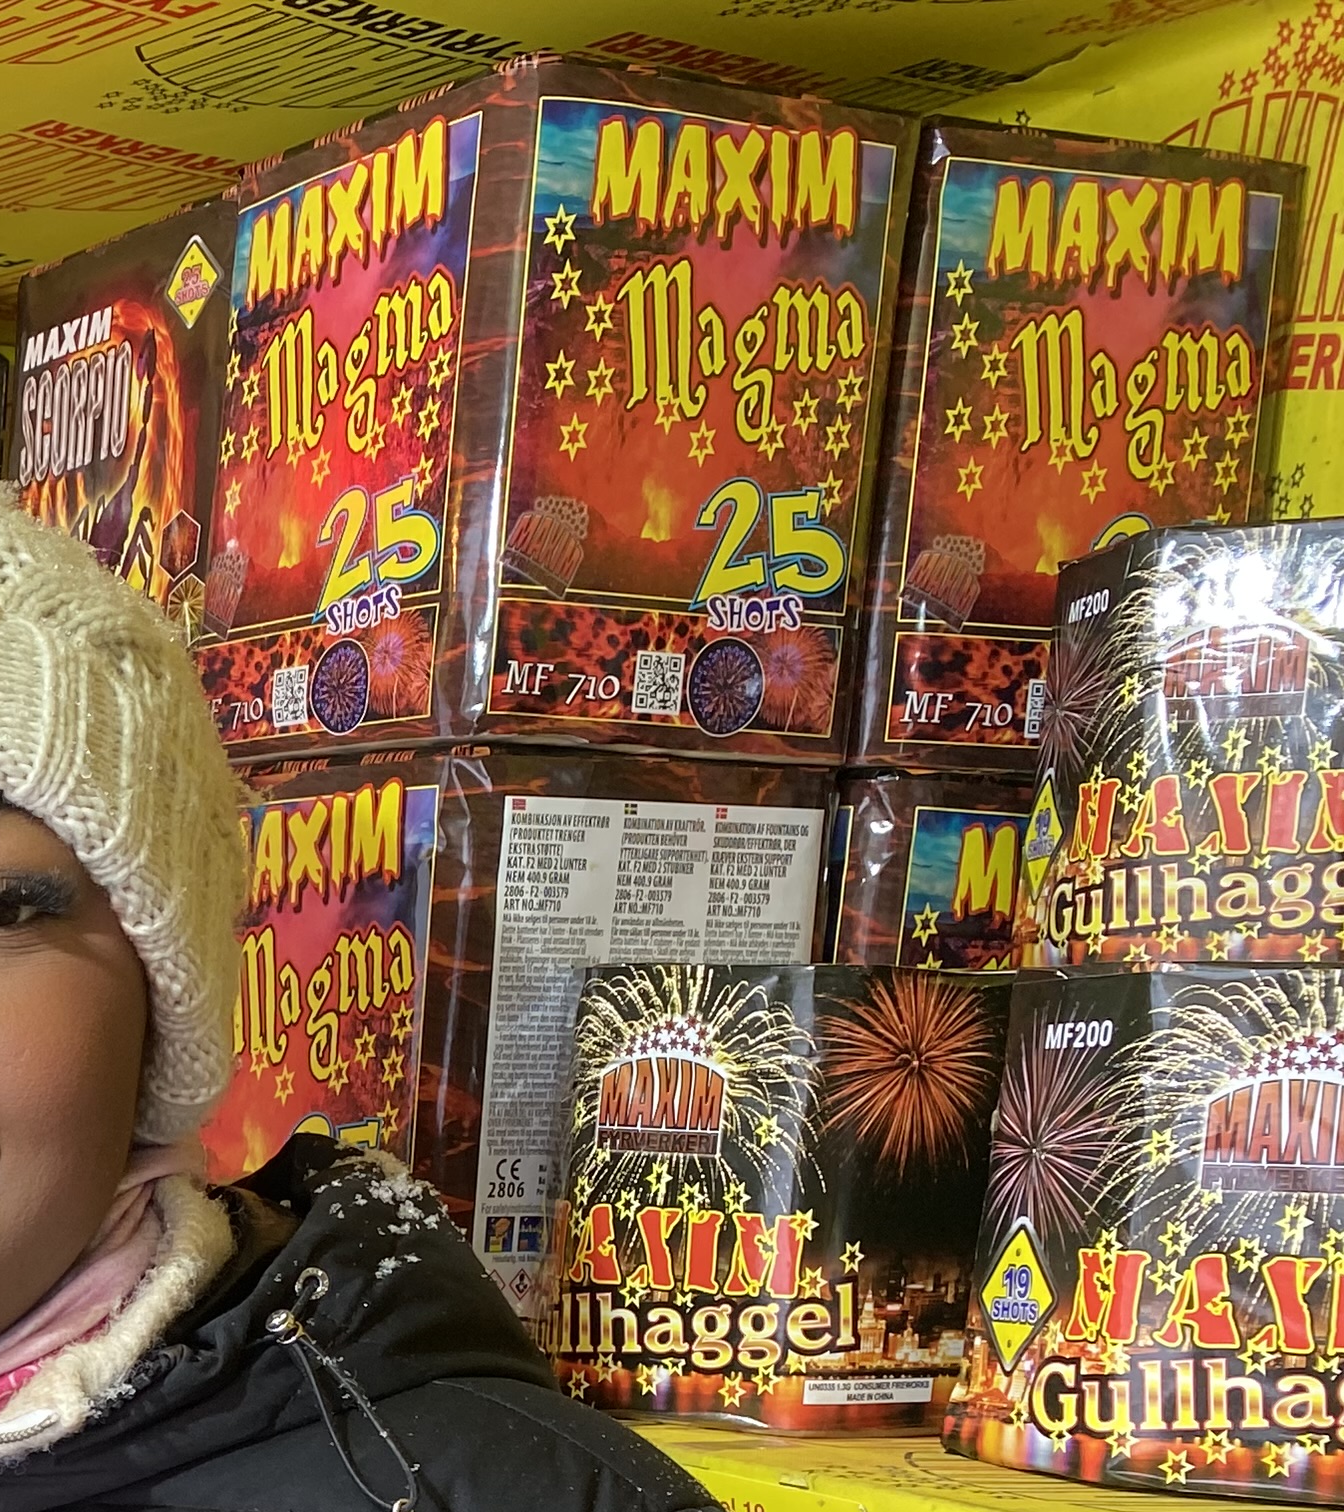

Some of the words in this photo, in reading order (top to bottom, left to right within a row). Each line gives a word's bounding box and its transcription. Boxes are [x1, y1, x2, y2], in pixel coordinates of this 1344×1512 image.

[592, 116, 859, 242] MAXIM
[246, 115, 449, 306] MAXIM
[987, 177, 1244, 290] MAXIM
[174, 280, 211, 305] SHOTS
[23, 305, 112, 372] MAXIM
[263, 266, 455, 459] Magma
[618, 258, 868, 446] Magma
[19, 340, 132, 488] SCORPIO
[1012, 308, 1254, 481] Magma
[315, 472, 442, 622] 25
[693, 474, 849, 612] 25
[325, 583, 404, 637] SHOTS
[706, 593, 805, 635] SHOTS
[1068, 589, 1110, 625] MF200
[503, 659, 552, 698] MF
[565, 671, 621, 706] 710
[230, 696, 264, 731] 710
[900, 690, 949, 726] MF
[964, 701, 1013, 735] 710
[238, 777, 405, 906] AXIM
[537, 858, 553, 870] MED
[560, 859, 587, 871] LUNTER
[505, 871, 525, 883] NEM
[548, 873, 570, 884] GRAM
[232, 924, 416, 1082] Magma
[1044, 1020, 1113, 1050] MF200
[599, 1057, 725, 1131] MAXIM
[1204, 1077, 1344, 1165] MAXI
[488, 1181, 525, 1199] 2806
[1002, 1263, 1032, 1300] 19
[991, 1297, 1040, 1323] SHOTS
[846, 1392, 865, 1401] MADE
[874, 1392, 894, 1401] CHINA
[853, 1381, 891, 1390] CONSUMER
